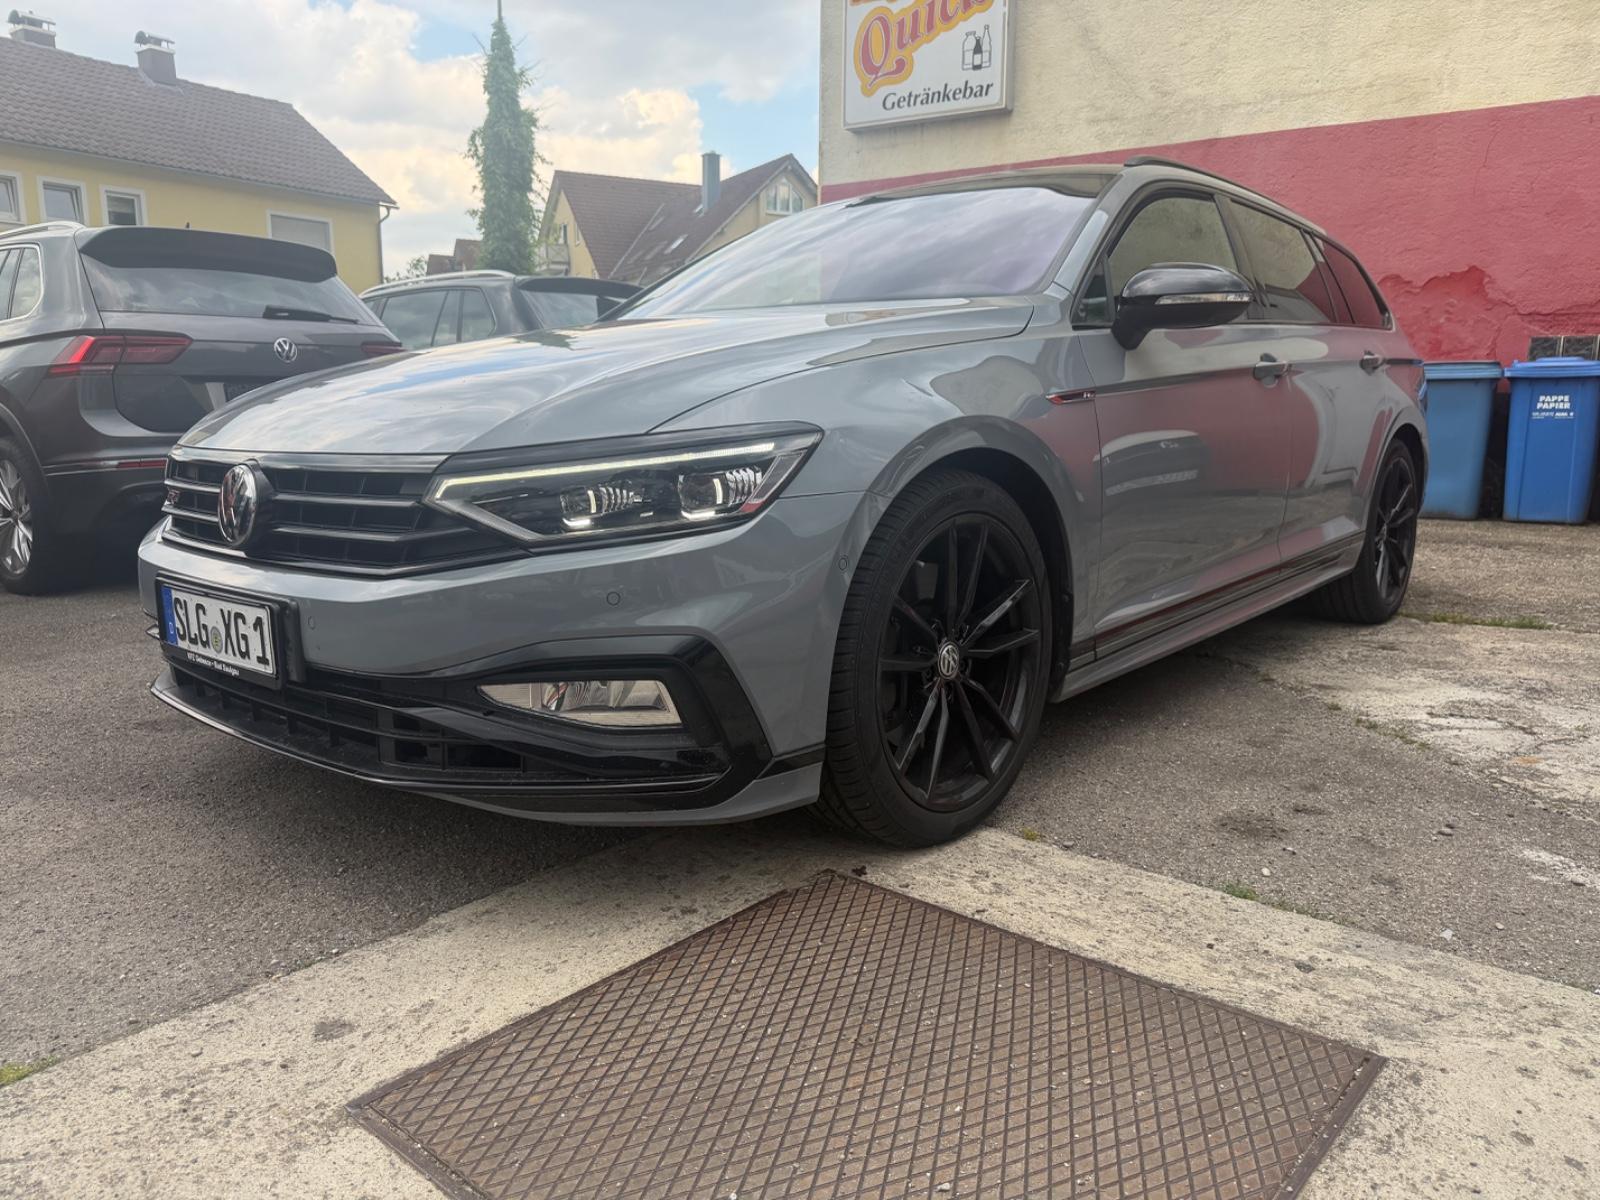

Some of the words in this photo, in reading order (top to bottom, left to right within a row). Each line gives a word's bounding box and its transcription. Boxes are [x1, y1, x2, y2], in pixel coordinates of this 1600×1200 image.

[861, 0, 989, 88] Quic
[882, 80, 994, 111] Getränkebar
[1536, 402, 1571, 410] PAPIER
[174, 597, 210, 649] SLG
